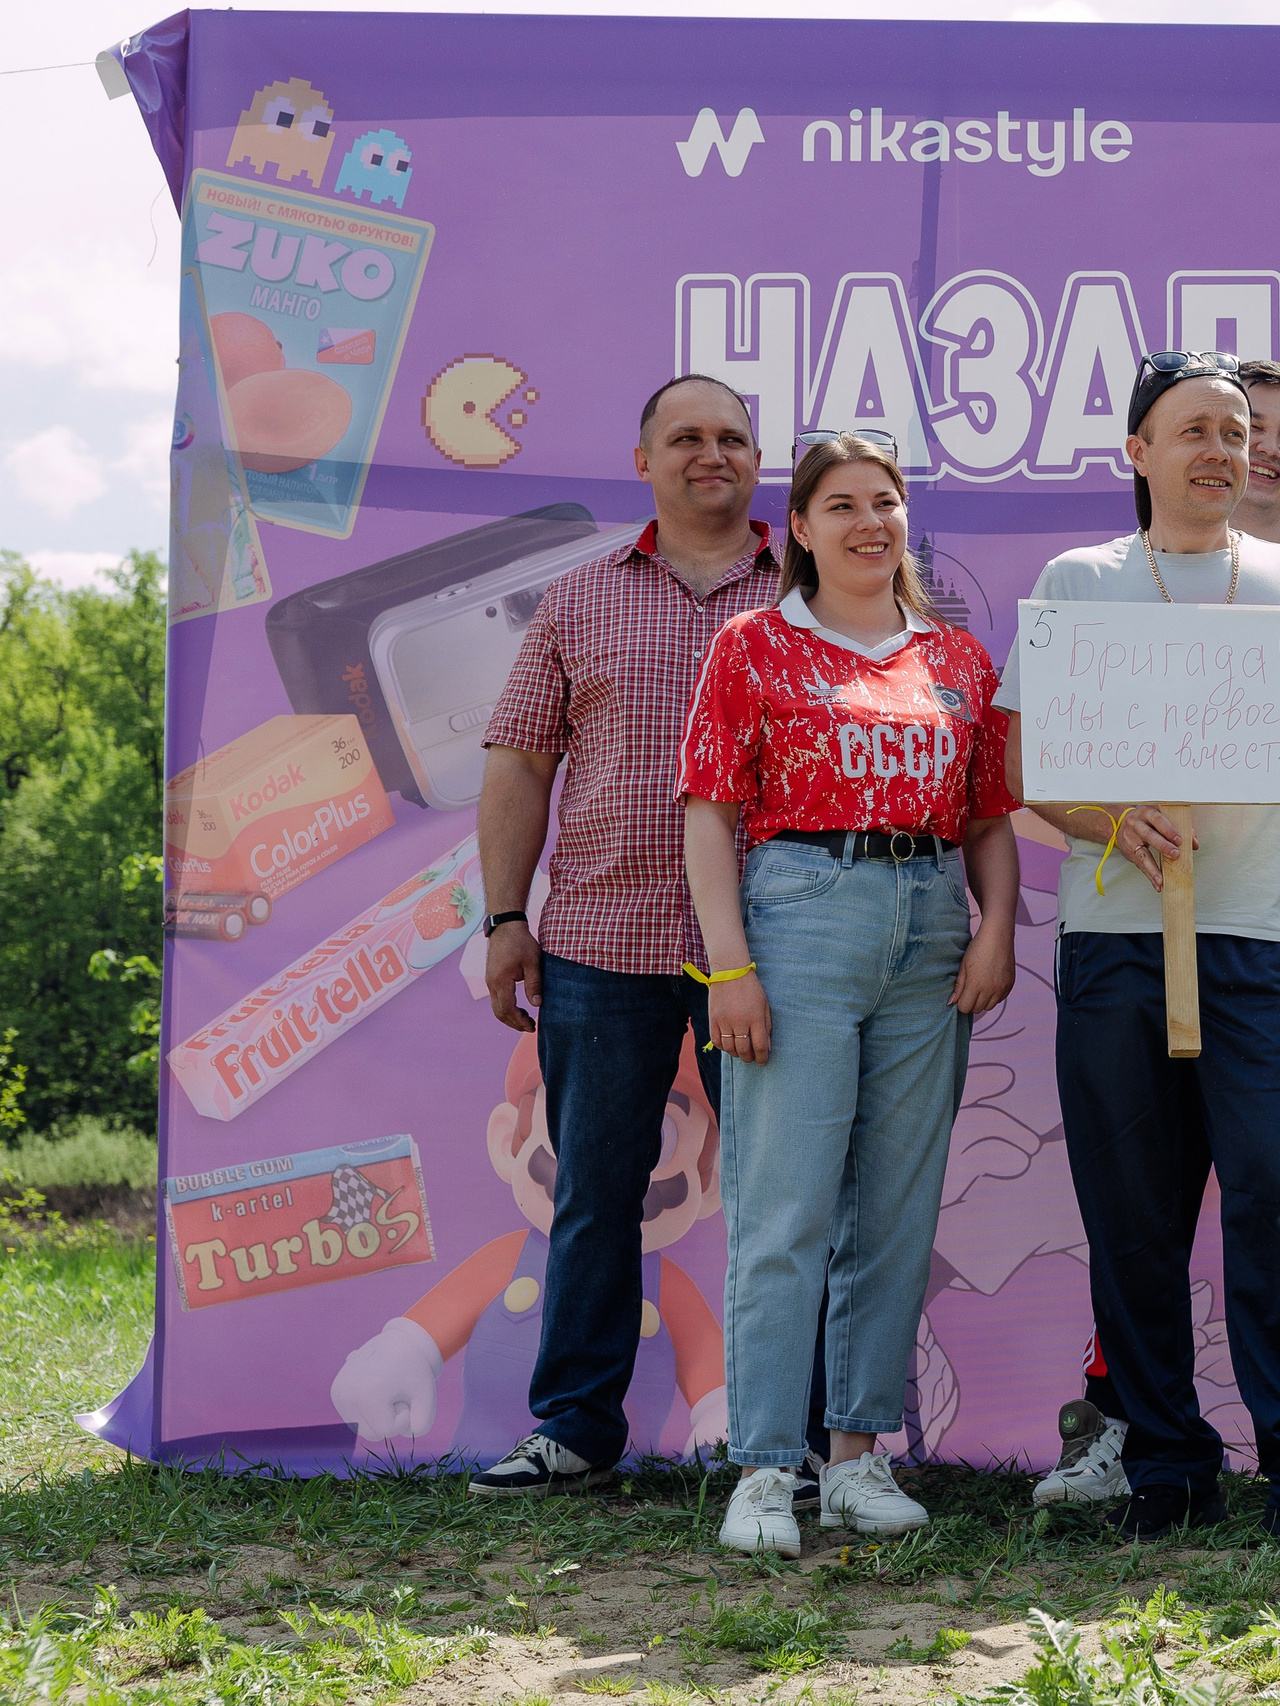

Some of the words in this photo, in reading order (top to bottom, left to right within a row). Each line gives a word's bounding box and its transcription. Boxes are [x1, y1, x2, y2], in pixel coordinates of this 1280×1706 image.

[802, 107, 1133, 178] nikastyle
[206, 188, 262, 211] НОВЫЙ!
[277, 206, 346, 231] МЯКОТЬЮ
[348, 222, 415, 247] ФРУКТОВ!
[194, 211, 396, 301] ZUKO
[250, 285, 322, 321] МАНГО
[1029, 609, 1057, 649] 5
[806, 696, 849, 707] adidas
[331, 737, 347, 754] 36
[338, 748, 361, 770] 200
[838, 723, 957, 780] СССР
[1039, 739, 1157, 770] класса
[229, 763, 308, 822] Kodak
[166, 811, 187, 826] dak
[202, 822, 217, 831] 200
[250, 794, 371, 878] ColorPlus
[168, 857, 212, 873] ColorPlus
[192, 913, 220, 925] MAX
[210, 943, 405, 1100] Fruit-tella
[175, 1166, 247, 1194] BUBBLE
[250, 1157, 294, 1178] GUM
[210, 1186, 294, 1222] k-artel
